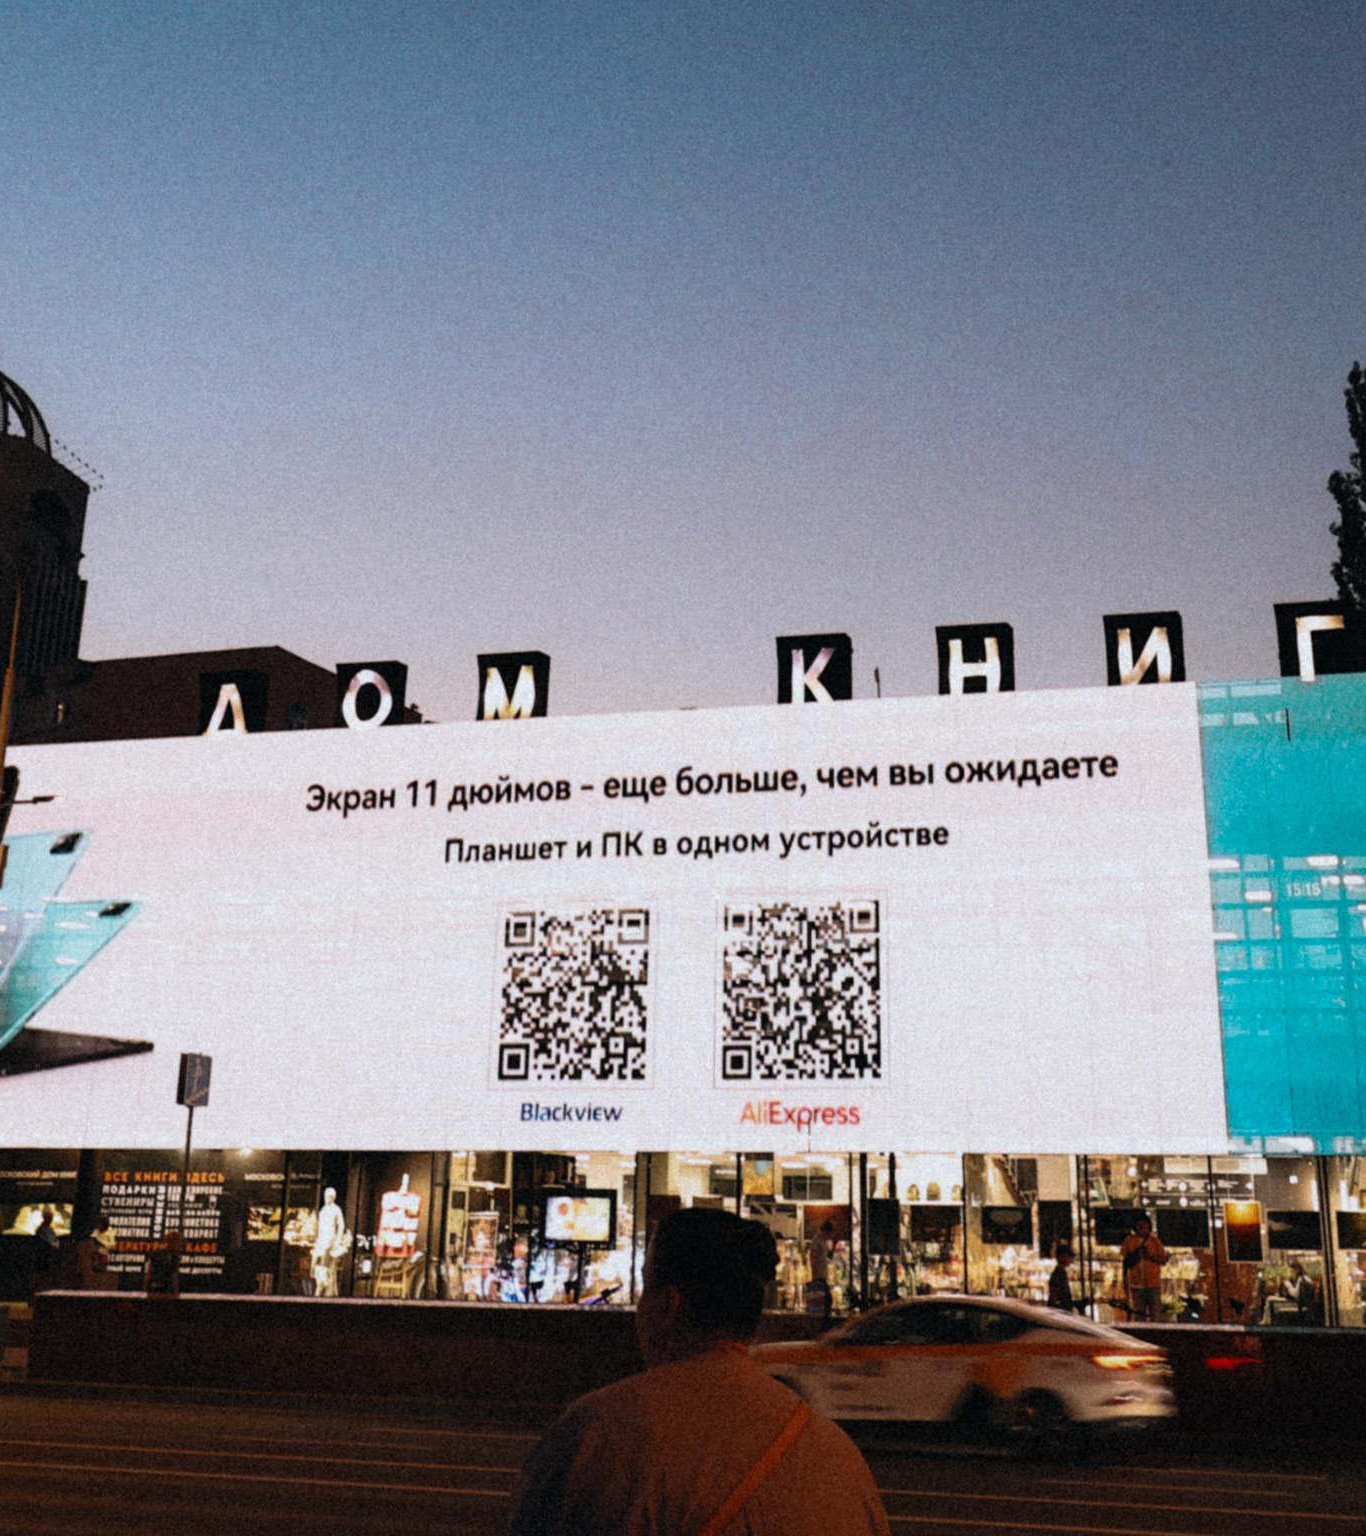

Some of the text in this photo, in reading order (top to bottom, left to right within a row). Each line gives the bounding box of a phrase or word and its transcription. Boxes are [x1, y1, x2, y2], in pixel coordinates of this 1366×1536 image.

[306, 784, 396, 818] Экран
[406, 779, 437, 807] 11
[447, 776, 571, 811] дюймов
[603, 775, 667, 803] еще
[676, 765, 808, 797] больше,
[817, 765, 878, 789] чем
[889, 762, 934, 786] вы
[945, 755, 1118, 787] ожидаете
[445, 821, 949, 863] Планшет и ПК в одном устройстве
[520, 1102, 623, 1122] Blackview
[739, 1101, 860, 1132] AliExpress
[104, 1171, 129, 1182] ВСЕ
[134, 1171, 178, 1183] КНИГИ
[102, 1185, 156, 1195] ПОДАРКИ
[101, 1197, 155, 1207] СУВЕНИРЫ
[185, 1242, 219, 1253] КАФЕ
